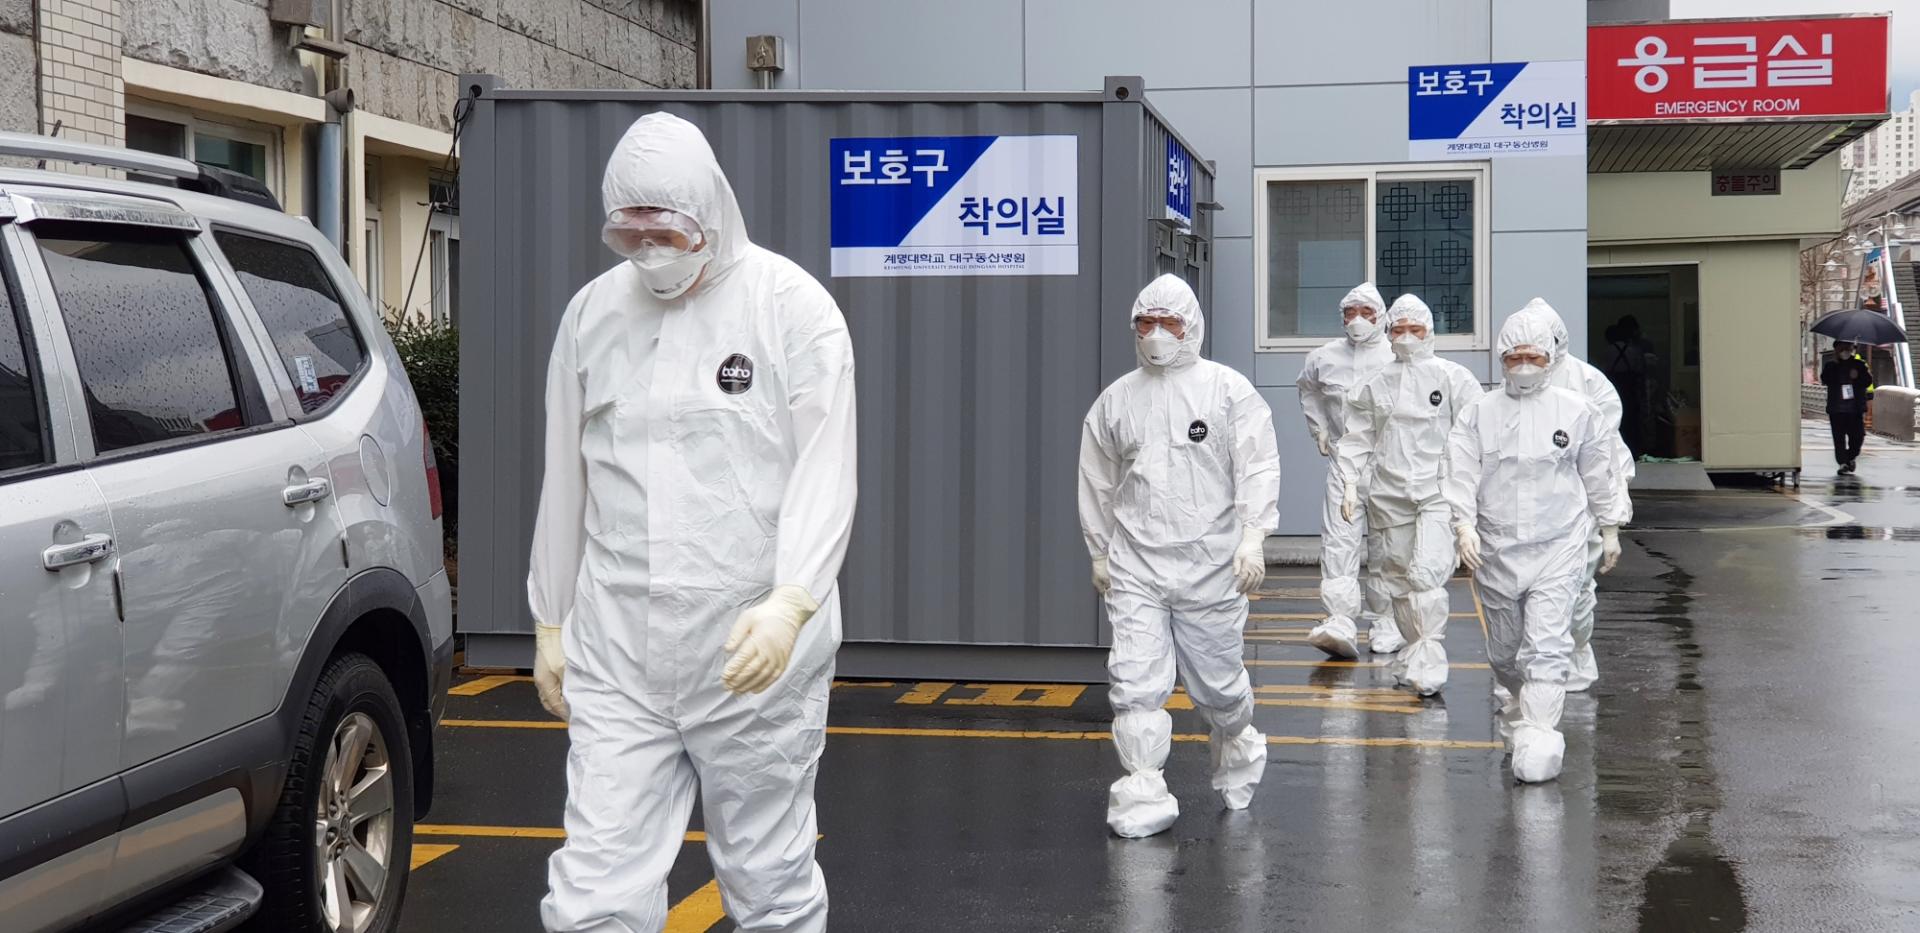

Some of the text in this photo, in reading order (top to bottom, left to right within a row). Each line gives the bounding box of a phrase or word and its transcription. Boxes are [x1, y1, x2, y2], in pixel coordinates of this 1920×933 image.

[1617, 33, 1833, 93] 응급실
[1416, 69, 1494, 96] 보호구
[1500, 102, 1577, 130] 착의실
[1655, 98, 1800, 115] EMERGENCY ROOM
[840, 150, 949, 187] 보호구
[958, 196, 1065, 236] 착의실
[884, 253, 1026, 264] 계명대학교 대구동산병원
